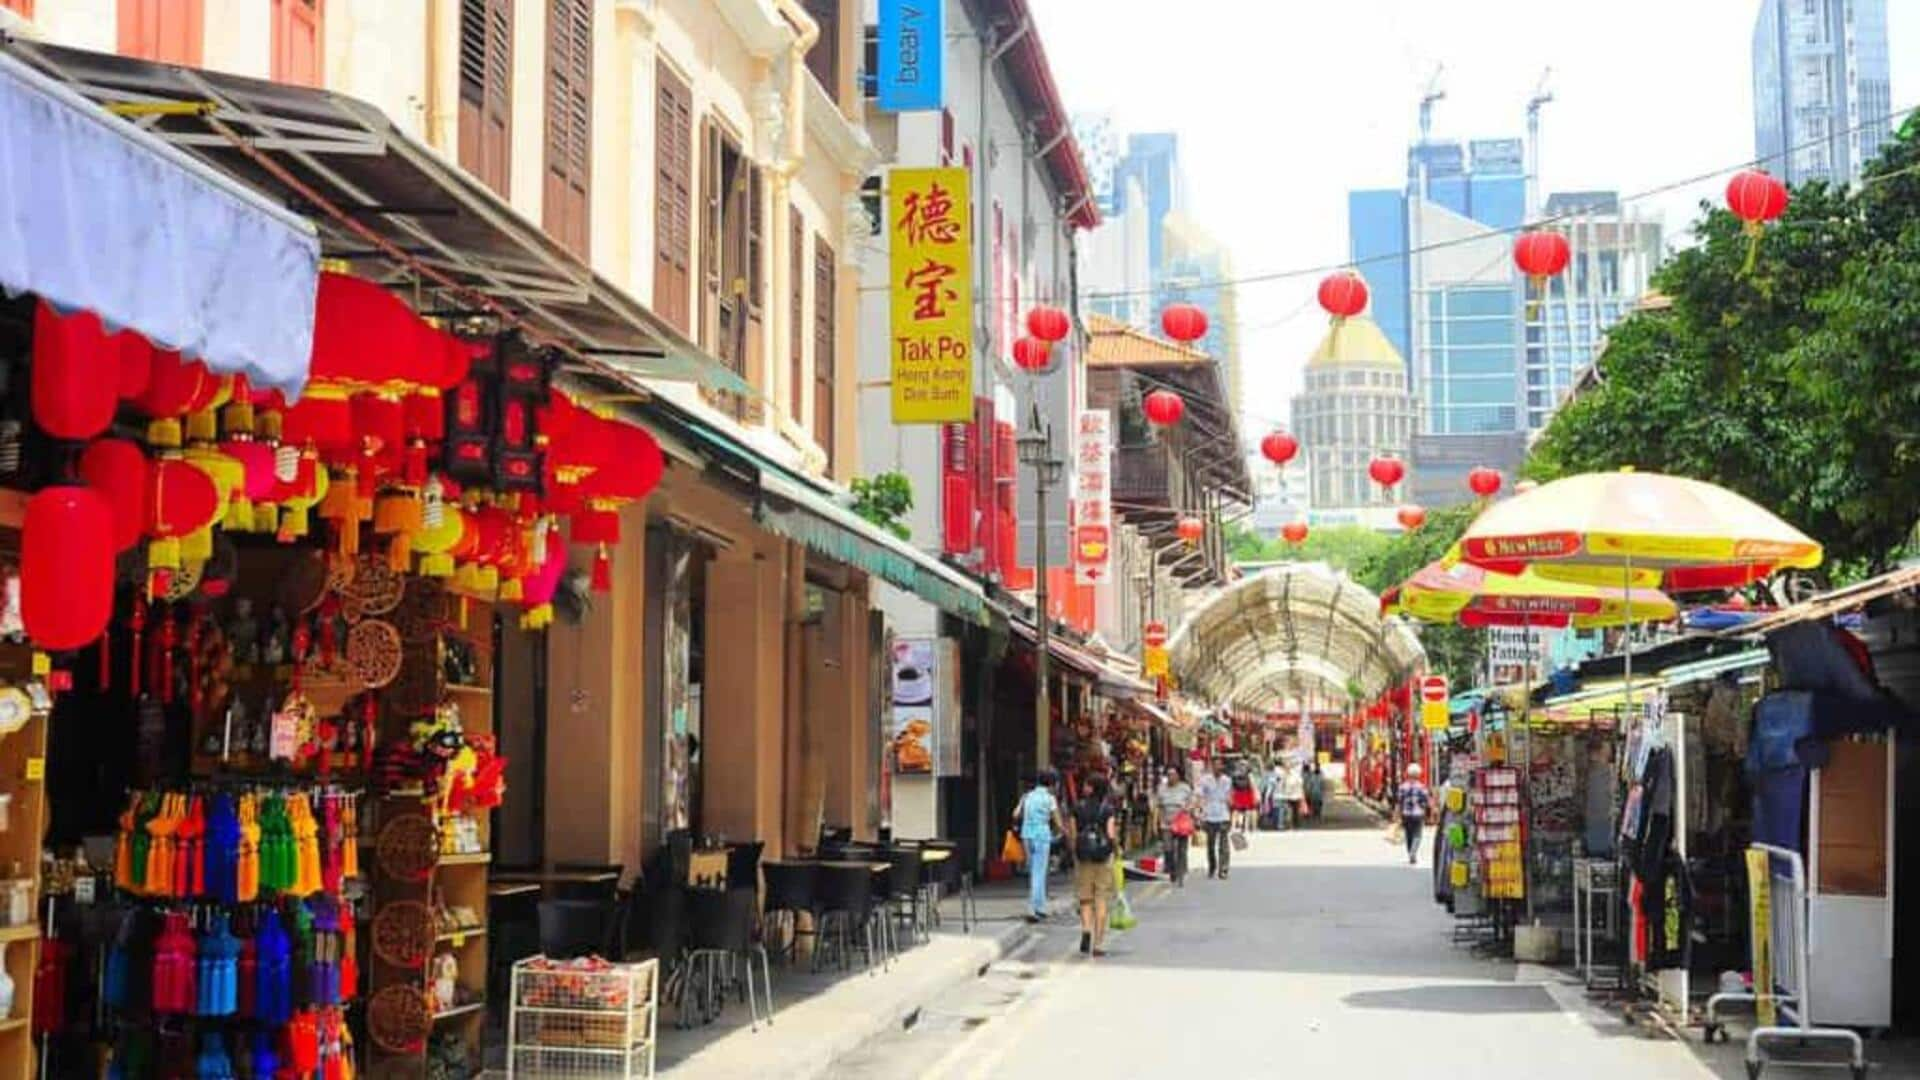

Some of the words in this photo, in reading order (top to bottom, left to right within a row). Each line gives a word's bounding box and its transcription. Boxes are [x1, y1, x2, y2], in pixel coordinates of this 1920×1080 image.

[898, 181, 960, 321] 德宝
[896, 336, 933, 361] Tak
[938, 336, 966, 360] Po
